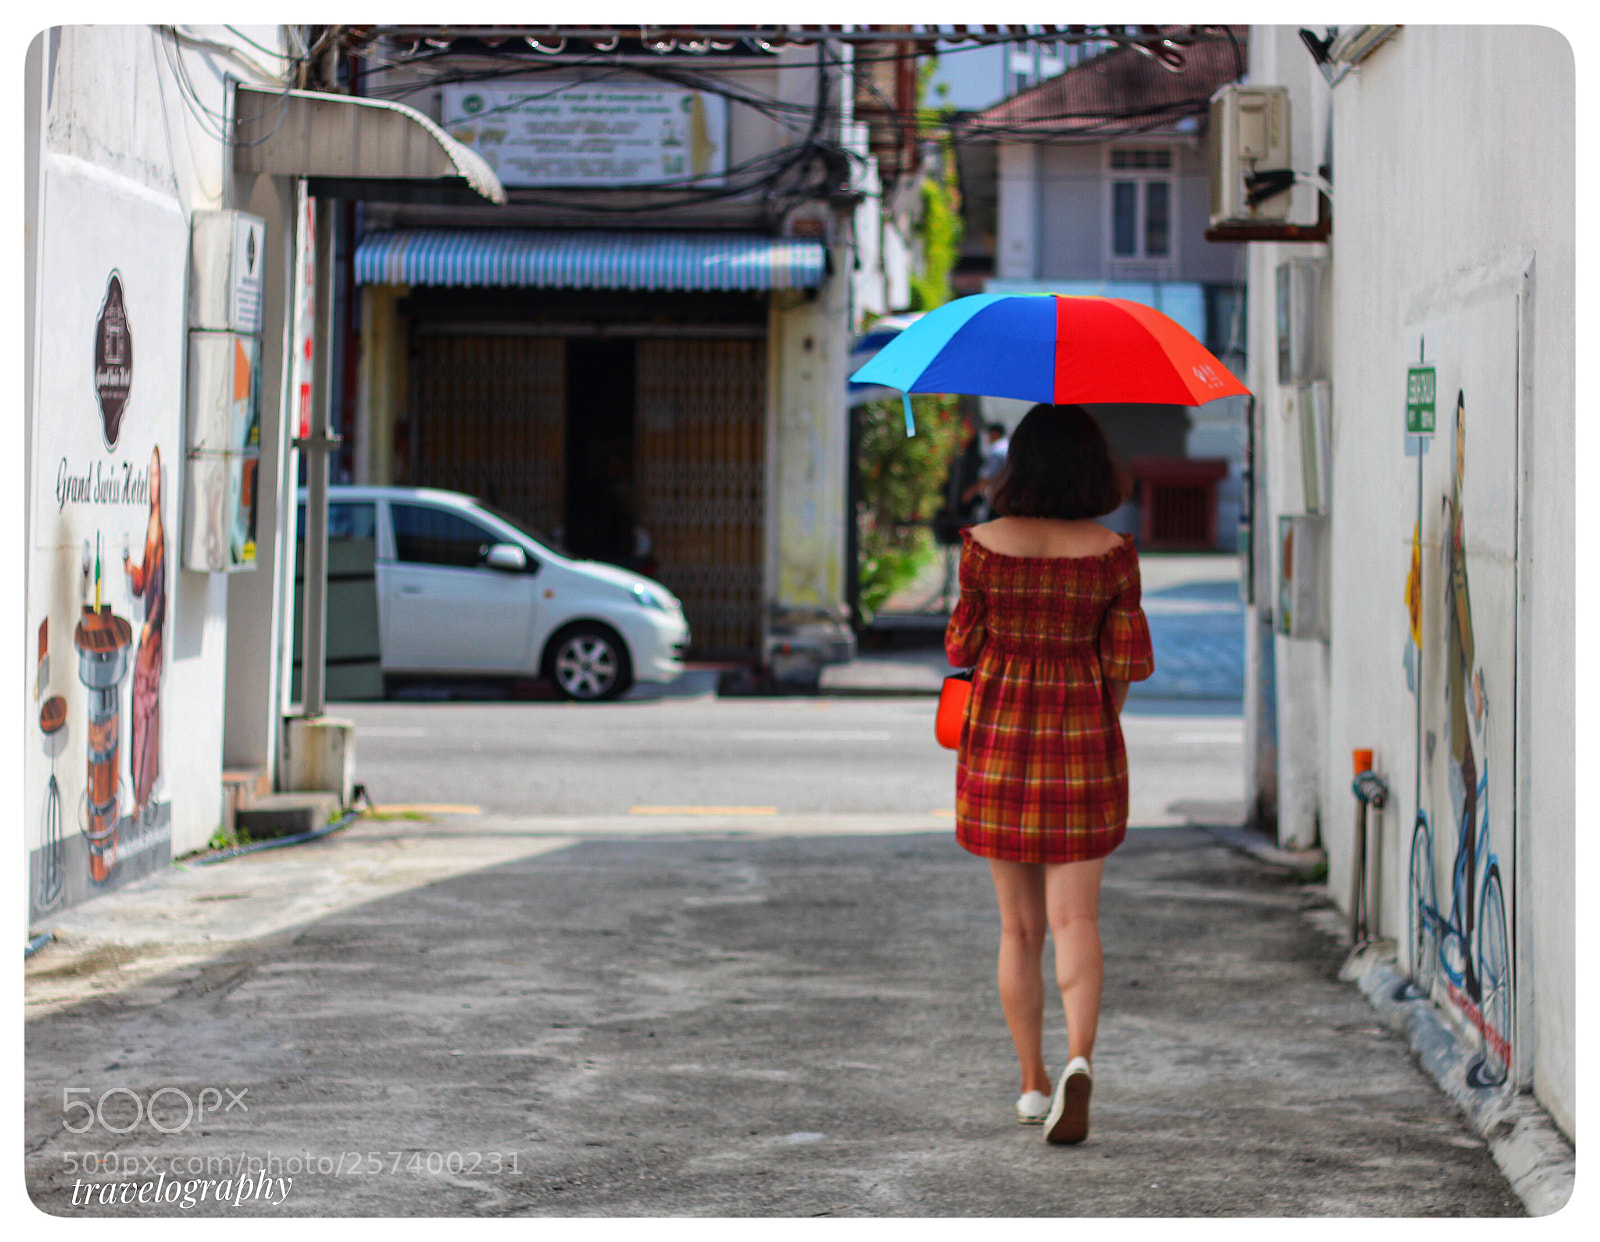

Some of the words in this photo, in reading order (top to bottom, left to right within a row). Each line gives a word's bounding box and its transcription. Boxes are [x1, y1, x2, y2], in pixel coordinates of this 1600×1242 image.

[56, 456, 92, 514] Grand
[93, 460, 120, 505] Swiss
[120, 461, 150, 505] Hotel
